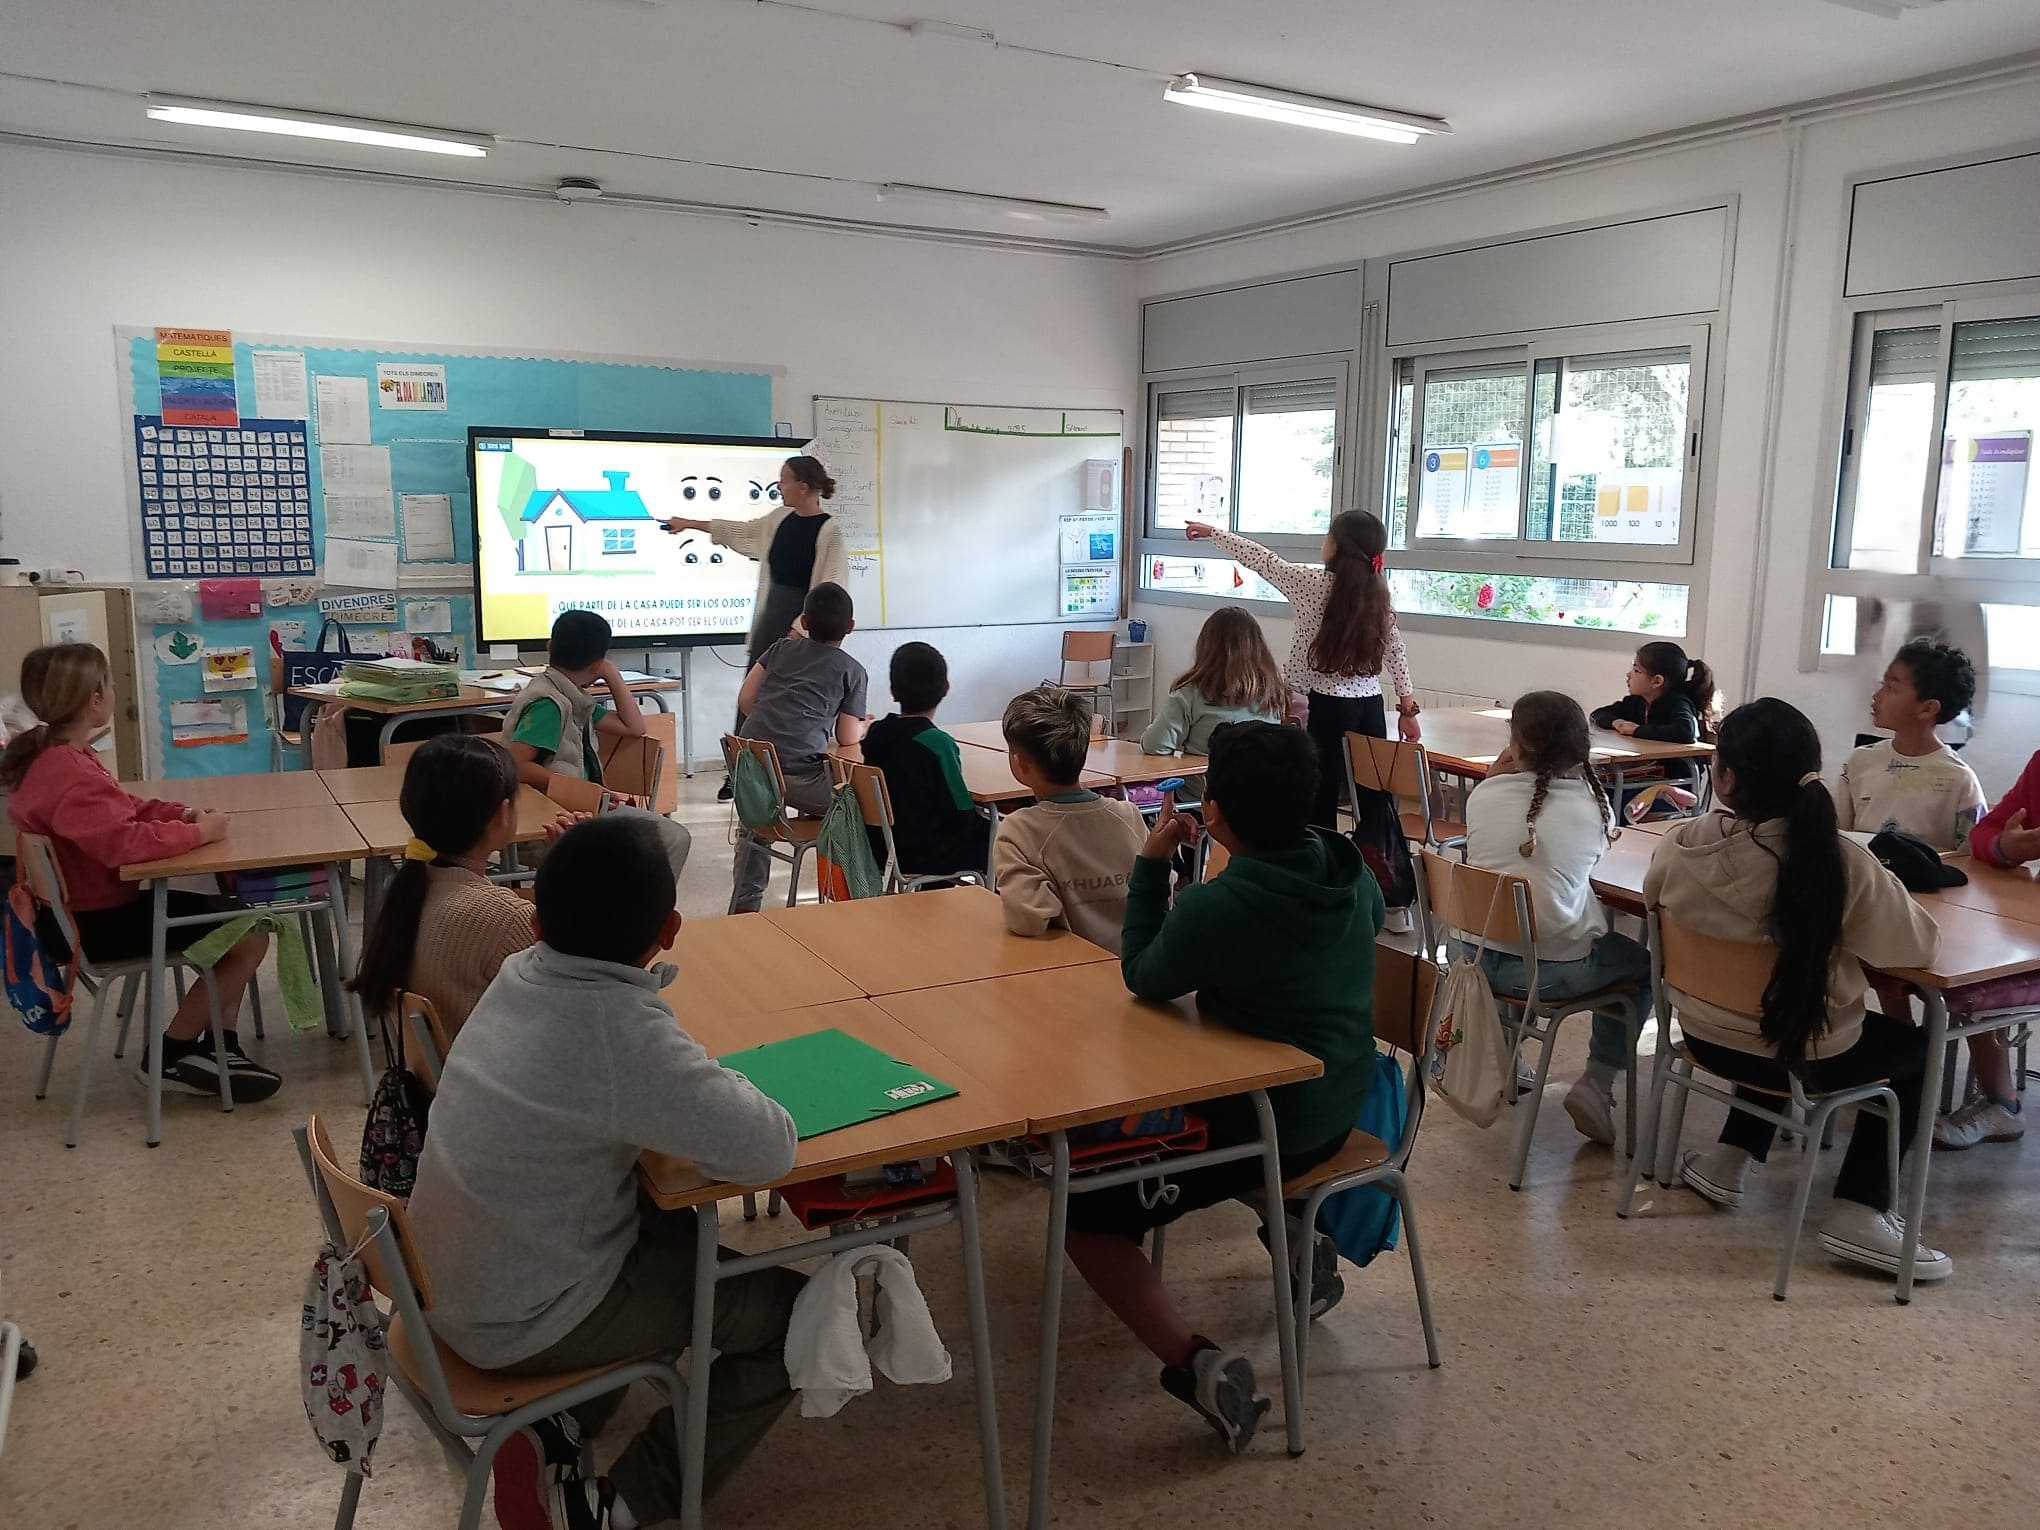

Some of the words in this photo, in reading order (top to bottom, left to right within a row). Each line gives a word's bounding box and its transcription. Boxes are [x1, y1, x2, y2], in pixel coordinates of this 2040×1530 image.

[1430, 458, 1436, 468] 3
[1480, 454, 1486, 464] 6
[322, 593, 394, 611] DIVENDRES
[580, 600, 604, 610] PARTE
[607, 600, 616, 610] DE
[620, 600, 631, 610] LA
[634, 600, 658, 610] CASA
[660, 599, 684, 608] PUEDE
[687, 599, 701, 608] SER
[704, 598, 719, 608] LOS
[722, 598, 750, 608] OJOS?
[618, 618, 627, 628] DE
[630, 618, 641, 628] LA
[644, 618, 667, 628] CASA
[670, 616, 685, 627] POT
[688, 616, 702, 626] SER
[704, 616, 717, 626] ELS
[720, 616, 744, 626] ULLS?
